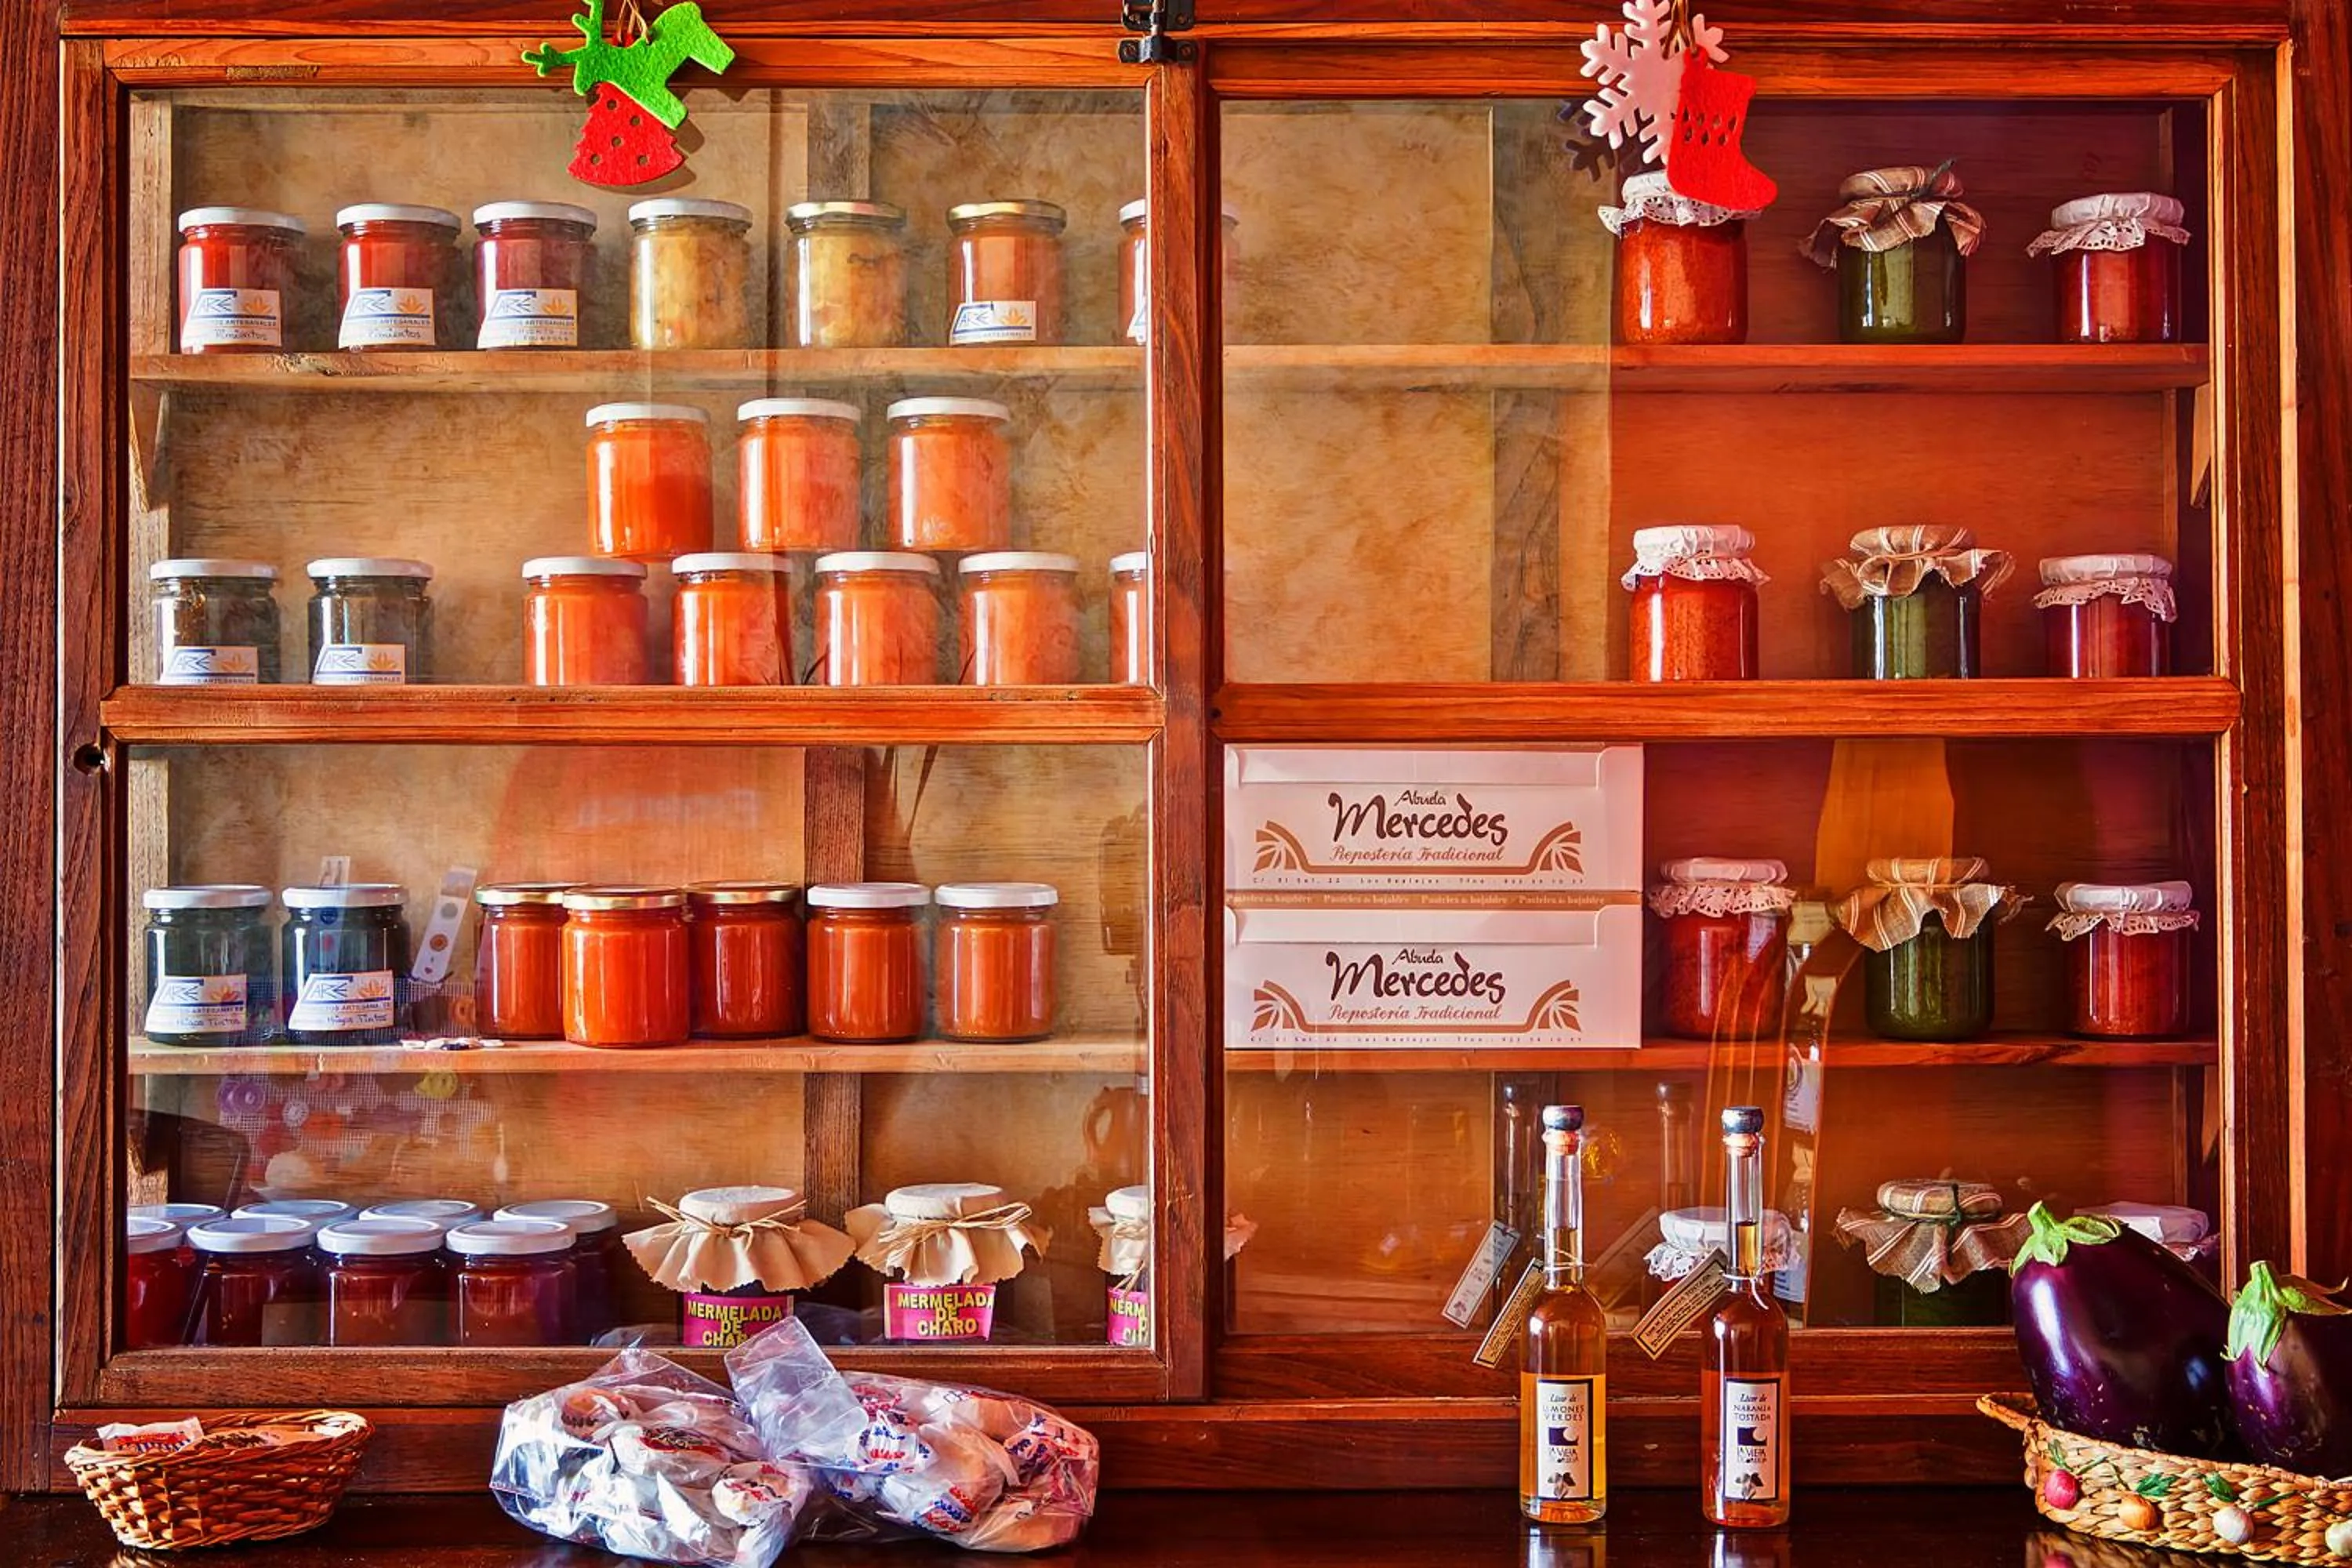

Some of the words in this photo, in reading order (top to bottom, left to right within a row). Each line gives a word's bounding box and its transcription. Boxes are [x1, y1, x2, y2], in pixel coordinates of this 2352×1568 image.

[1327, 792, 1508, 846] Mercedes
[1330, 844, 1413, 864] Repostería
[1417, 846, 1506, 862] Tradicional
[1325, 951, 1505, 1004] Mercedes
[1329, 1004, 1410, 1022] Repostería
[1414, 1004, 1502, 1020] Tradicional
[898, 1291, 996, 1308] MERMELADA
[1109, 1298, 1147, 1318] MERM
[688, 1300, 782, 1322] MERMELADA
[935, 1305, 957, 1321] DE
[720, 1317, 742, 1334] DE
[917, 1318, 978, 1335] CHARO
[702, 1330, 750, 1347] CHAR
[1543, 1404, 1584, 1413] LIMONES
[1733, 1412, 1771, 1421] TOSTADA
